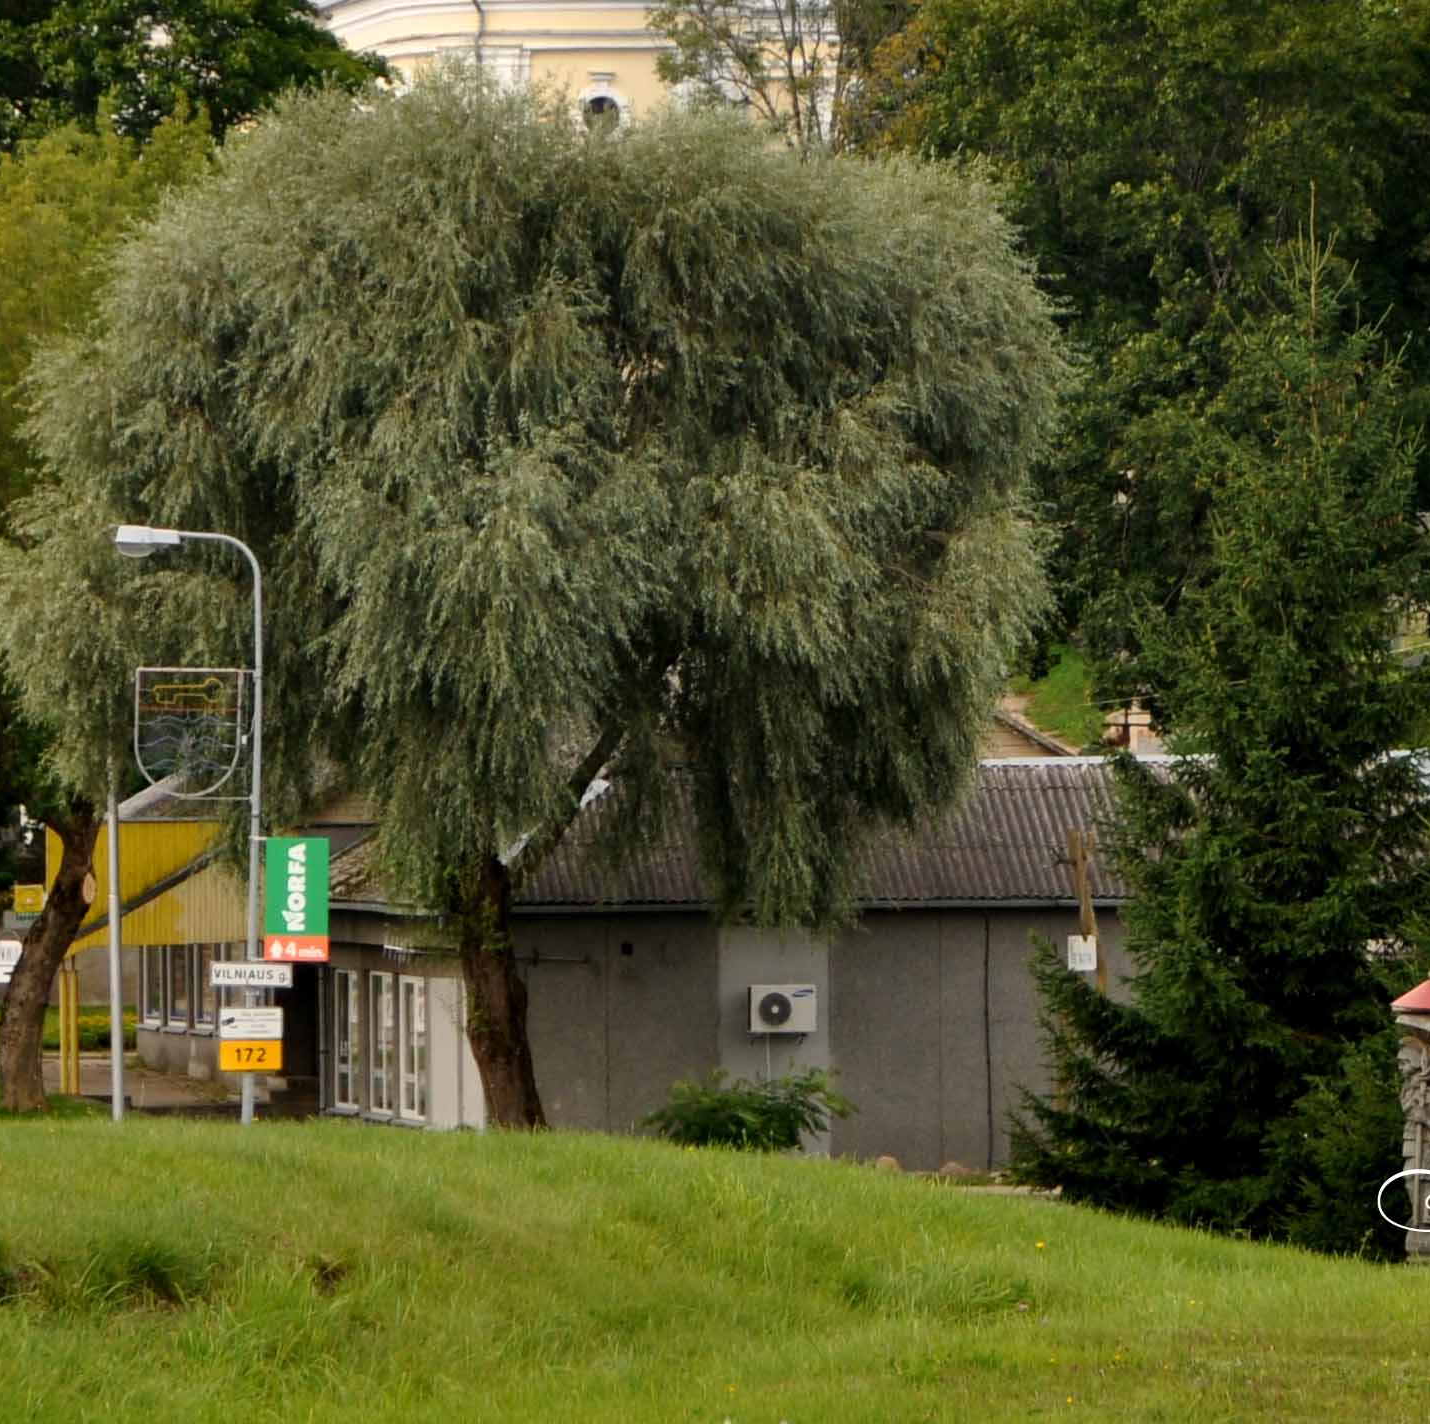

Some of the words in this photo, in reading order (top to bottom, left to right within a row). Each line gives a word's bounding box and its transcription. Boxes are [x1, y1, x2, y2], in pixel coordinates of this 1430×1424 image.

[281, 843, 307, 932] NORFA
[284, 941, 297, 957] 4
[213, 968, 275, 981] VILNIAUS
[235, 1048, 267, 1063] 172
